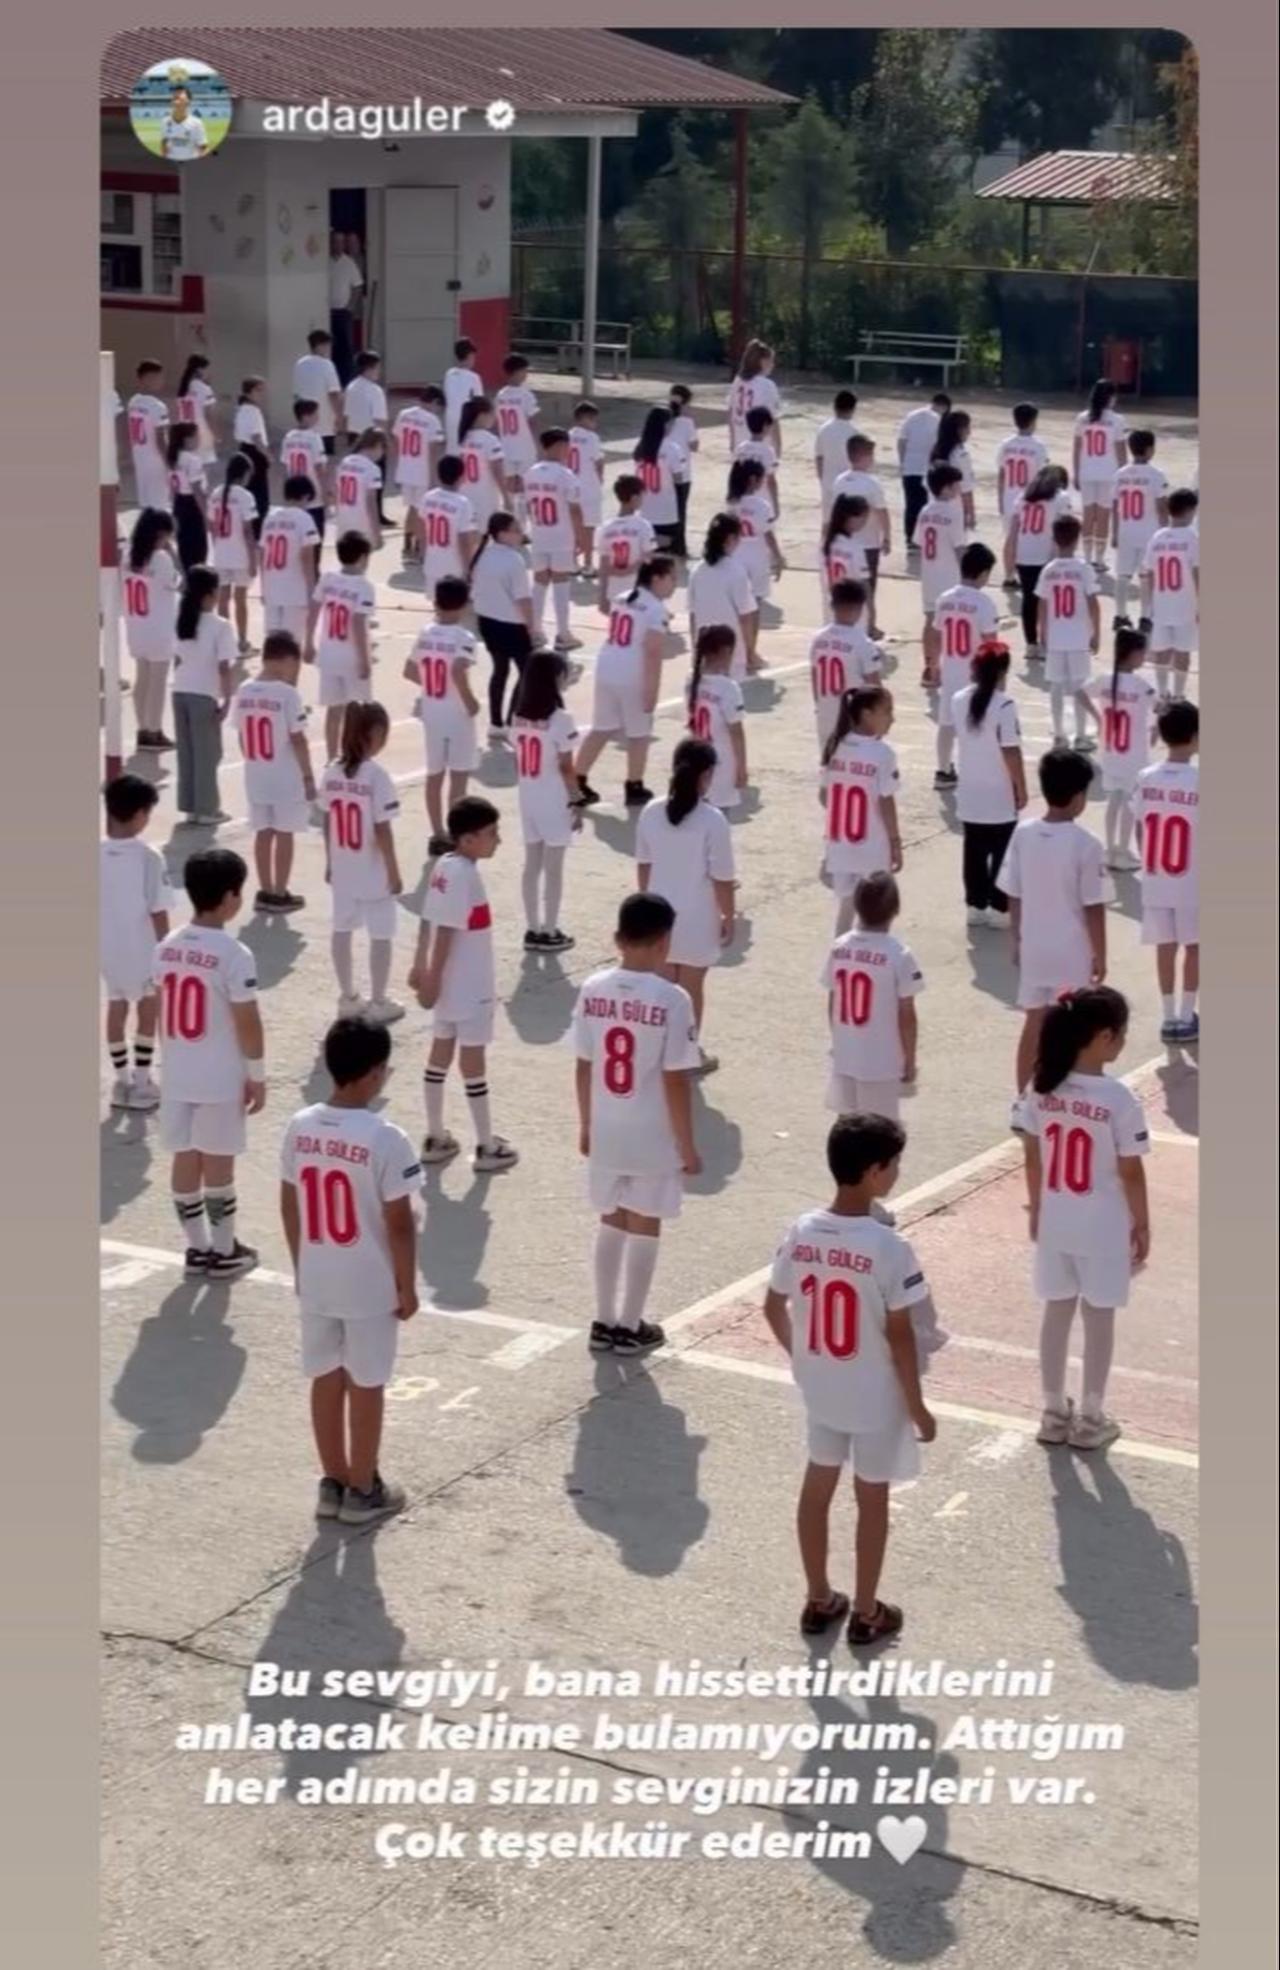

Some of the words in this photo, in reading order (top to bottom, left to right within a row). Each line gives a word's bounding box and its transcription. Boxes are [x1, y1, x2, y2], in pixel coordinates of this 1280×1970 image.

[401, 427, 422, 457] 10
[1084, 429, 1107, 456] 10
[338, 475, 358, 506] 10
[1005, 459, 1028, 488] 10
[530, 497, 557, 526] 10
[1022, 503, 1046, 534] 10
[1119, 489, 1144, 520] 10
[426, 512, 450, 547] 10
[924, 526, 937, 560] 8
[265, 534, 289, 570] 10
[1156, 556, 1183, 591] 10
[124, 577, 149, 617] 10
[1052, 584, 1076, 618] 10
[326, 600, 351, 640] 10
[609, 611, 633, 647] 10
[943, 616, 971, 657] 10
[420, 656, 448, 700] 10
[817, 656, 845, 697] 10
[244, 715, 274, 761] 10
[517, 734, 542, 778] 10
[329, 798, 363, 851] 10
[828, 782, 869, 843] 10
[1144, 811, 1190, 875] 10
[162, 971, 207, 1041] 10
[834, 968, 874, 1027] 10
[603, 1026, 635, 1096] 8
[325, 1137, 370, 1166] GÜLER
[1044, 1121, 1093, 1194] 10
[299, 1164, 359, 1245] 10
[827, 1246, 874, 1275] GÜLER
[800, 1272, 859, 1358] 10
